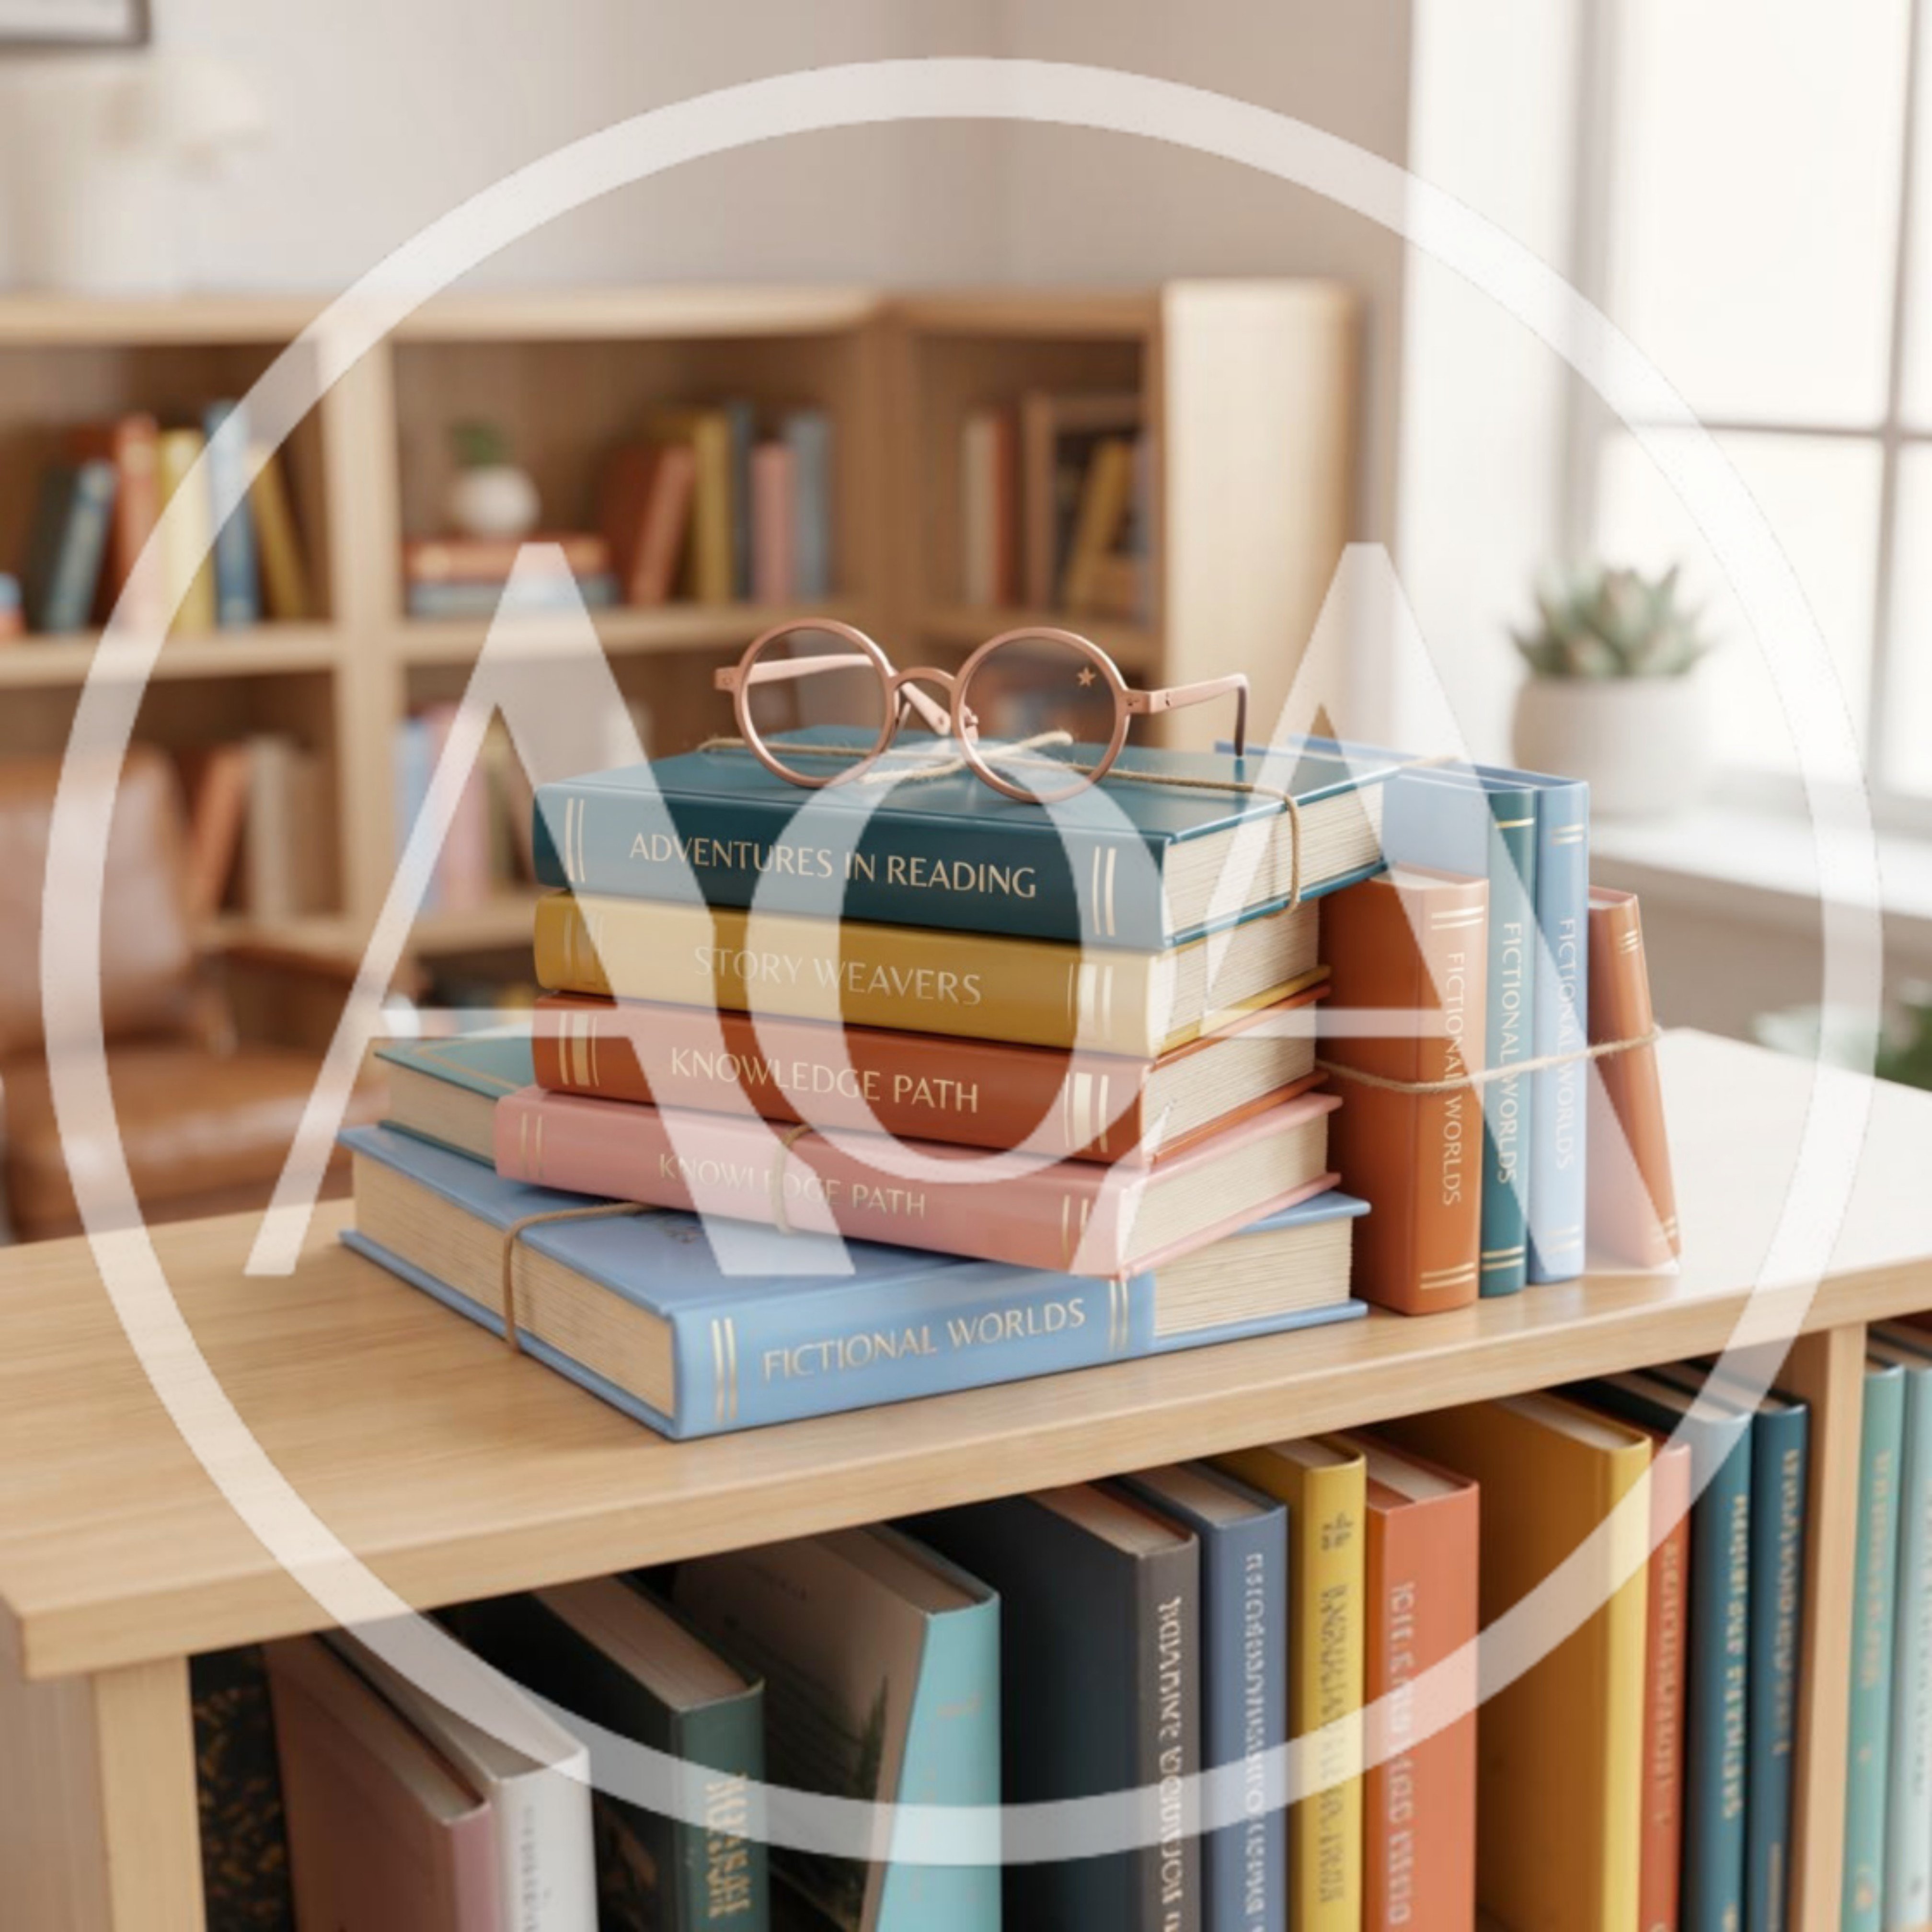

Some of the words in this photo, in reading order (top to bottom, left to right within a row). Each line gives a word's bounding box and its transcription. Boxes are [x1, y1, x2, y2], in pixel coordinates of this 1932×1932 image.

[629, 833, 833, 878] ADVENTURES
[845, 850, 874, 882] IN
[887, 855, 1037, 898] READING
[694, 946, 803, 984] STORY
[813, 957, 982, 1005] WEAVERS
[1500, 922, 1522, 1064] FICTIONAL
[1557, 919, 1576, 1056] FICTIONAL
[671, 1047, 881, 1101] KNOWLEDGE
[893, 1074, 978, 1113] PATH
[1556, 1062, 1575, 1170] WORLDS
[1442, 1094, 1462, 1206] WORLDS
[851, 1183, 926, 1219] PATH
[763, 1324, 938, 1381] FICTIONAL
[947, 1298, 1087, 1348] WORLDS
